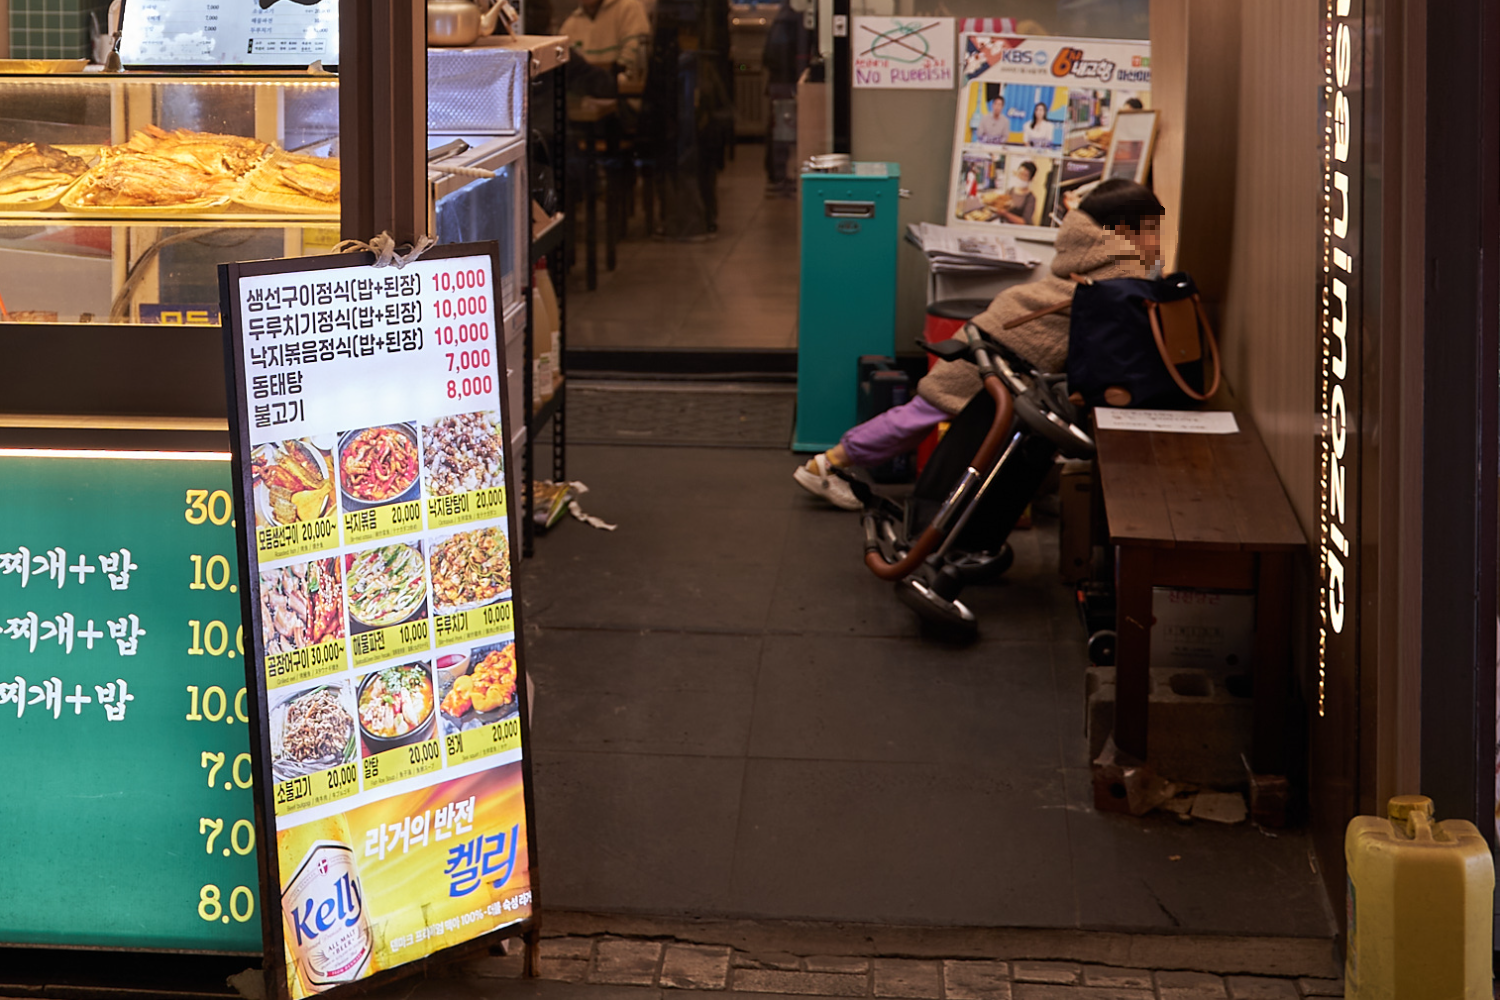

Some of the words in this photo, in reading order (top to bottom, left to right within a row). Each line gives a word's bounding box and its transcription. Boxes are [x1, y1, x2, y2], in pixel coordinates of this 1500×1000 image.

[856, 68, 882, 85] NO
[890, 66, 951, 83] RUBBISH
[1001, 49, 1033, 65] KBS
[246, 272, 422, 313] 생선구이정식(밥+된장)
[431, 268, 486, 294] 10,000
[248, 300, 423, 341] 두루치기정식(밥+된장)
[433, 295, 488, 320] 10,000
[250, 326, 424, 370] 낙지볶음정식(밥+된장)
[434, 321, 490, 347] 10,000
[252, 370, 304, 400] 동태탕
[445, 348, 491, 374] 7,000
[254, 398, 305, 429] 불고기
[446, 374, 493, 401] 8,000
[344, 508, 378, 533] 낙지볶음
[391, 503, 421, 525] 20,000
[475, 487, 504, 511] 20,000
[352, 629, 386, 657] 해물파전
[399, 622, 428, 646] 10,000
[435, 611, 469, 638] 두루치기
[482, 604, 511, 627] 10,000
[267, 649, 311, 679] 곰장어구이
[446, 733, 464, 756] 멍게
[492, 720, 518, 744] 20,000
[200, 751, 254, 791] 7.0
[363, 756, 380, 780] 알탕
[408, 743, 440, 767] 20,000
[277, 774, 312, 805] 소불고기
[327, 764, 358, 791] 20,000
[198, 817, 257, 858] 7.0
[364, 809, 431, 861] 라거의
[434, 796, 476, 839] 반전
[443, 823, 519, 897] 켈리
[197, 883, 256, 925] 8.0
[290, 871, 362, 947] Kelly
